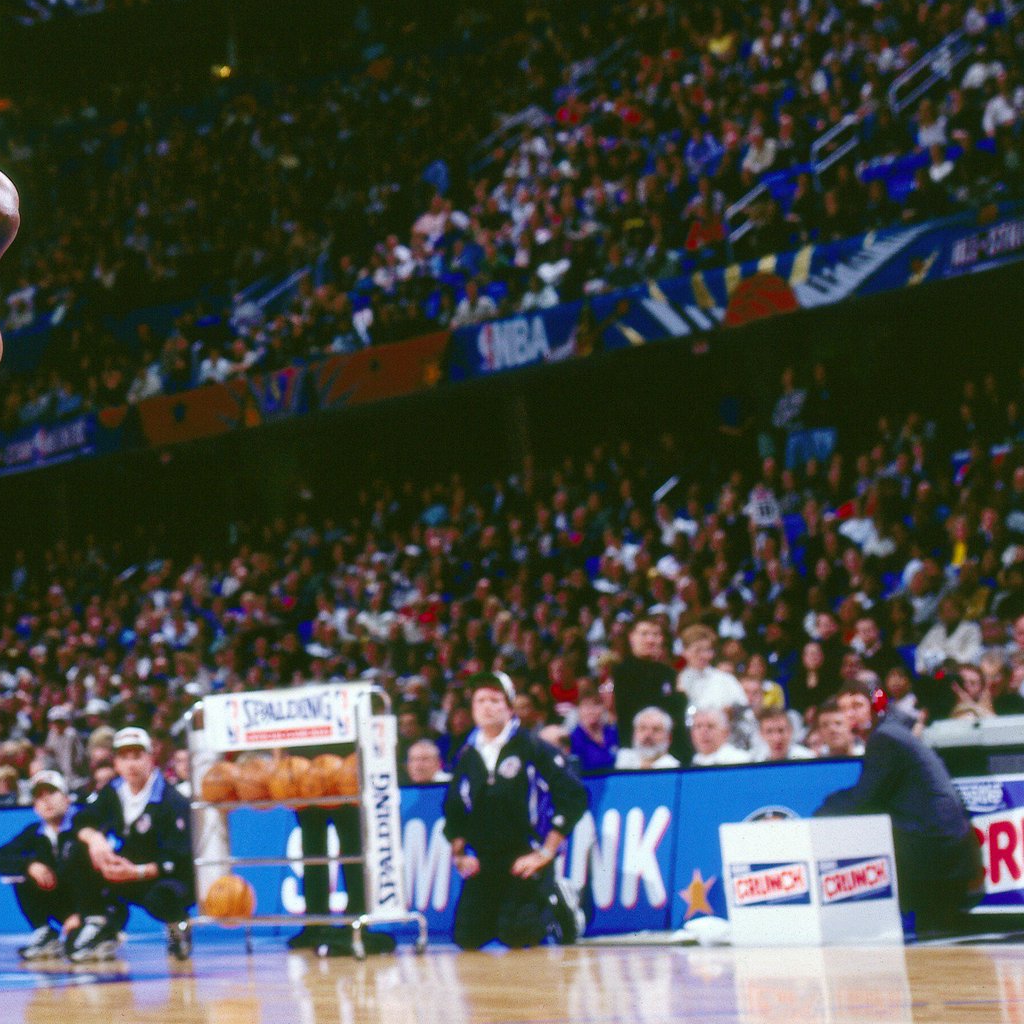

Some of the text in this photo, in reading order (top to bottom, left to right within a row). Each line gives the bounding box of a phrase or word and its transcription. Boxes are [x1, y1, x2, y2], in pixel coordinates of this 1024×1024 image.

[492, 314, 549, 369] NBA
[242, 690, 334, 728] SPALDING
[372, 772, 396, 906] SPALDING
[737, 867, 802, 899] CRUNCH
[824, 862, 885, 898] CRUNCH
